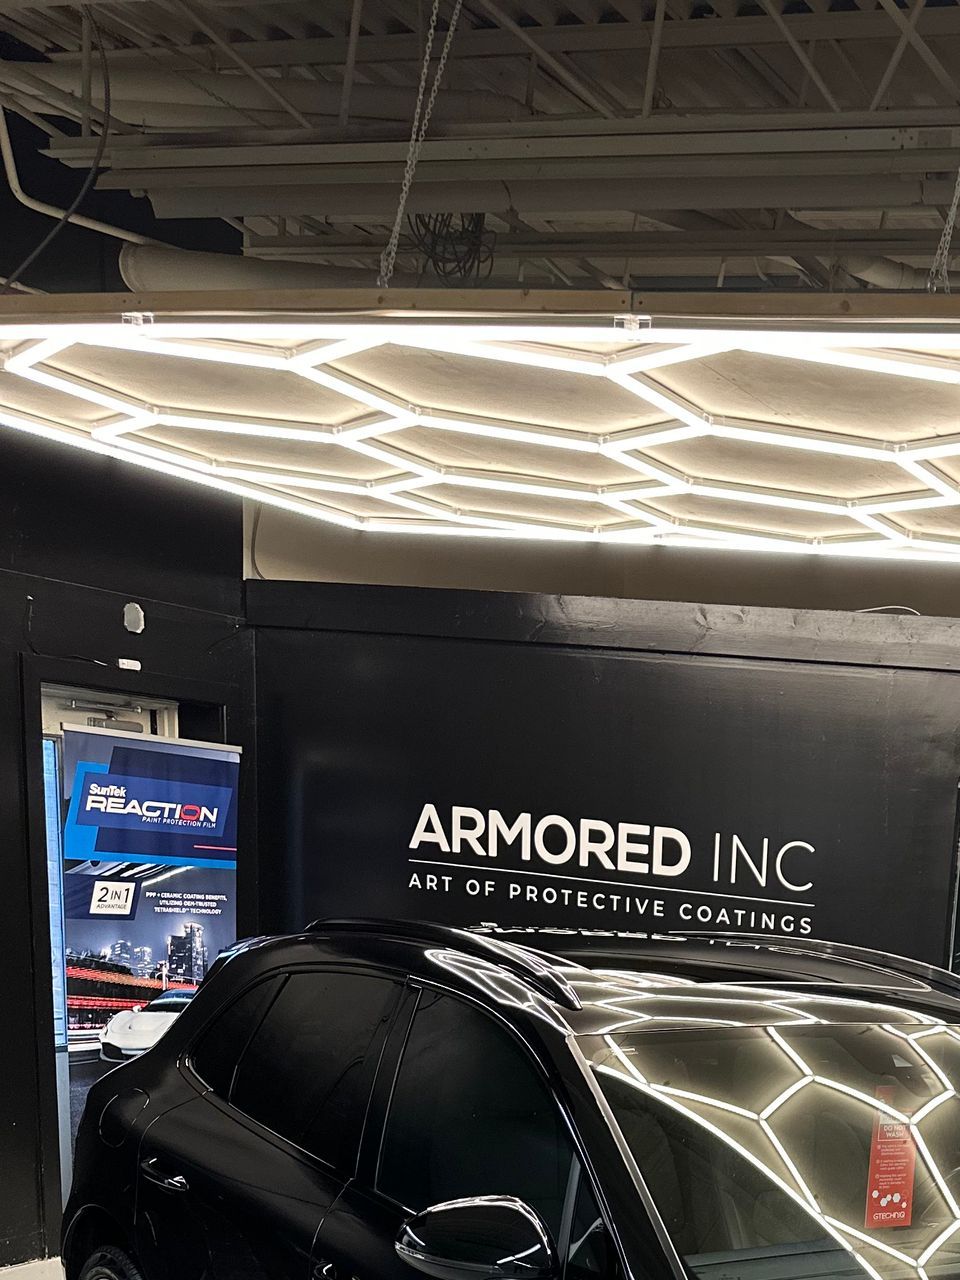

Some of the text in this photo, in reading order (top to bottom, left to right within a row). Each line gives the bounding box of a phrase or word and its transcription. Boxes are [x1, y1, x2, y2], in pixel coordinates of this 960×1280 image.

[89, 783, 127, 797] SunTek
[86, 795, 218, 822] REACTION
[163, 818, 200, 827] PROTECTION
[408, 803, 816, 892] ARMORED INC
[98, 886, 130, 903] 2 IN 1
[408, 873, 453, 892] ART
[466, 879, 496, 896] OF
[510, 883, 665, 917] PROTECTIVE
[679, 903, 812, 934] COATINGS
